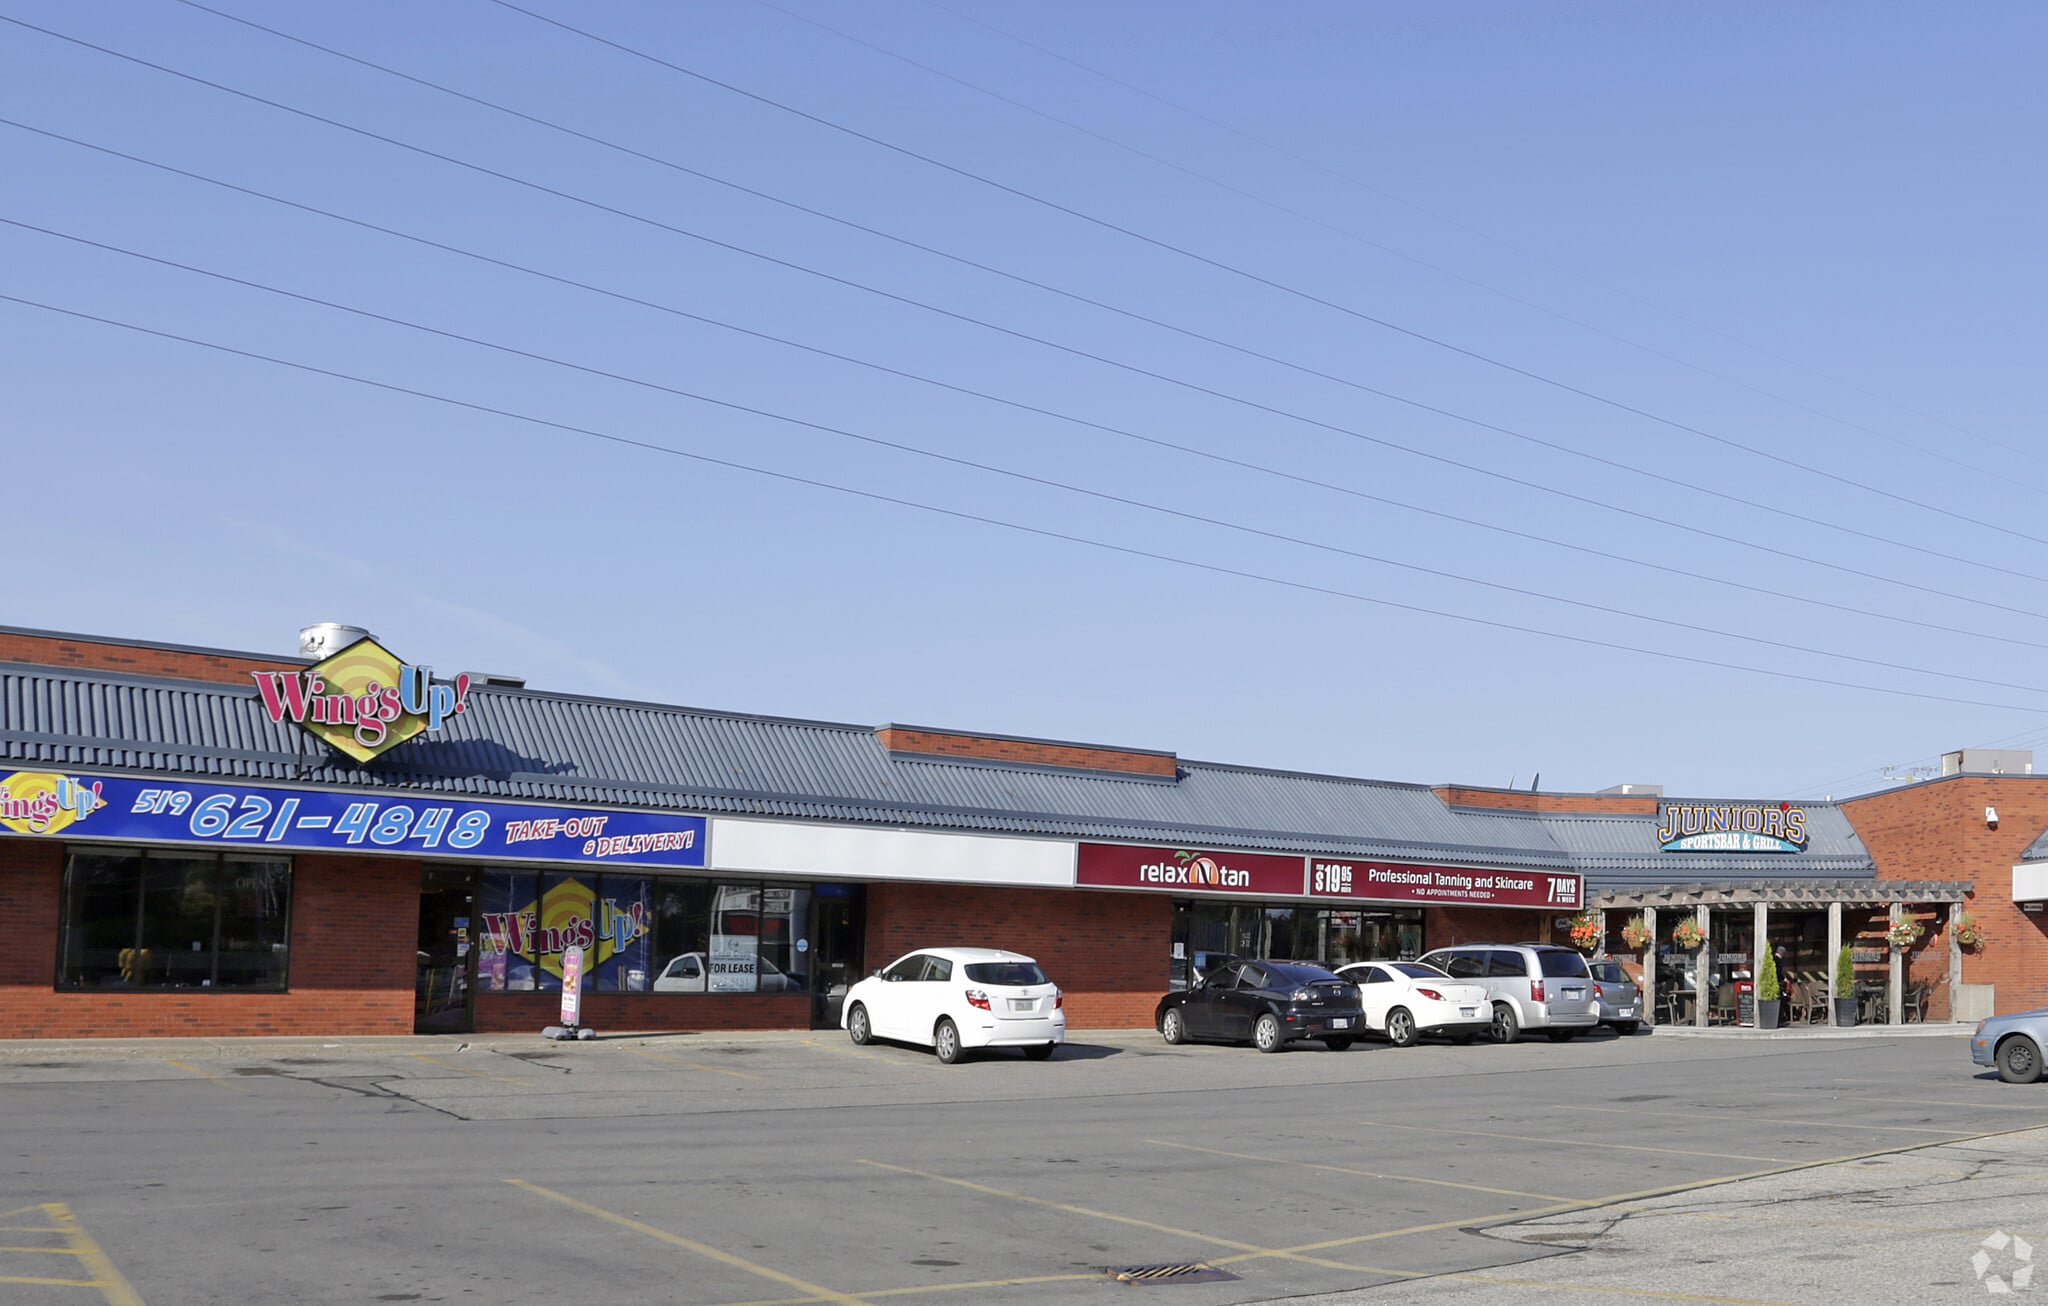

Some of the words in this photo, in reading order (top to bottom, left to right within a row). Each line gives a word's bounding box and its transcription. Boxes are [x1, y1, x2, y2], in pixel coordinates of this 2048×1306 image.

[251, 671, 401, 747] Wings
[400, 664, 470, 731] Up!
[0, 786, 60, 833] ings
[56, 777, 103, 821] Up!
[131, 788, 192, 816] 519
[189, 793, 492, 849] 621-4848
[506, 816, 608, 844] TAKE-OUT
[596, 830, 695, 857] DELIVERY!
[1680, 831, 1741, 850] SPORTSBAR
[1742, 833, 1750, 850] &
[1752, 833, 1782, 850] GRILL
[1140, 862, 1187, 884] relax
[1220, 865, 1249, 887] tan
[1369, 868, 1432, 885] Professional
[1434, 872, 1472, 890] Tanning
[1474, 876, 1493, 888] and
[1495, 876, 1534, 891] Skincare
[1416, 888, 1425, 896] NO
[1426, 888, 1468, 898] APPOINTMENTS
[1469, 891, 1491, 899] NEEDED
[1547, 877, 1556, 903] 7
[1556, 878, 1576, 894] DAYS
[590, 898, 643, 954] Up!
[709, 963, 727, 974] FOR
[728, 963, 755, 974] LEASE
